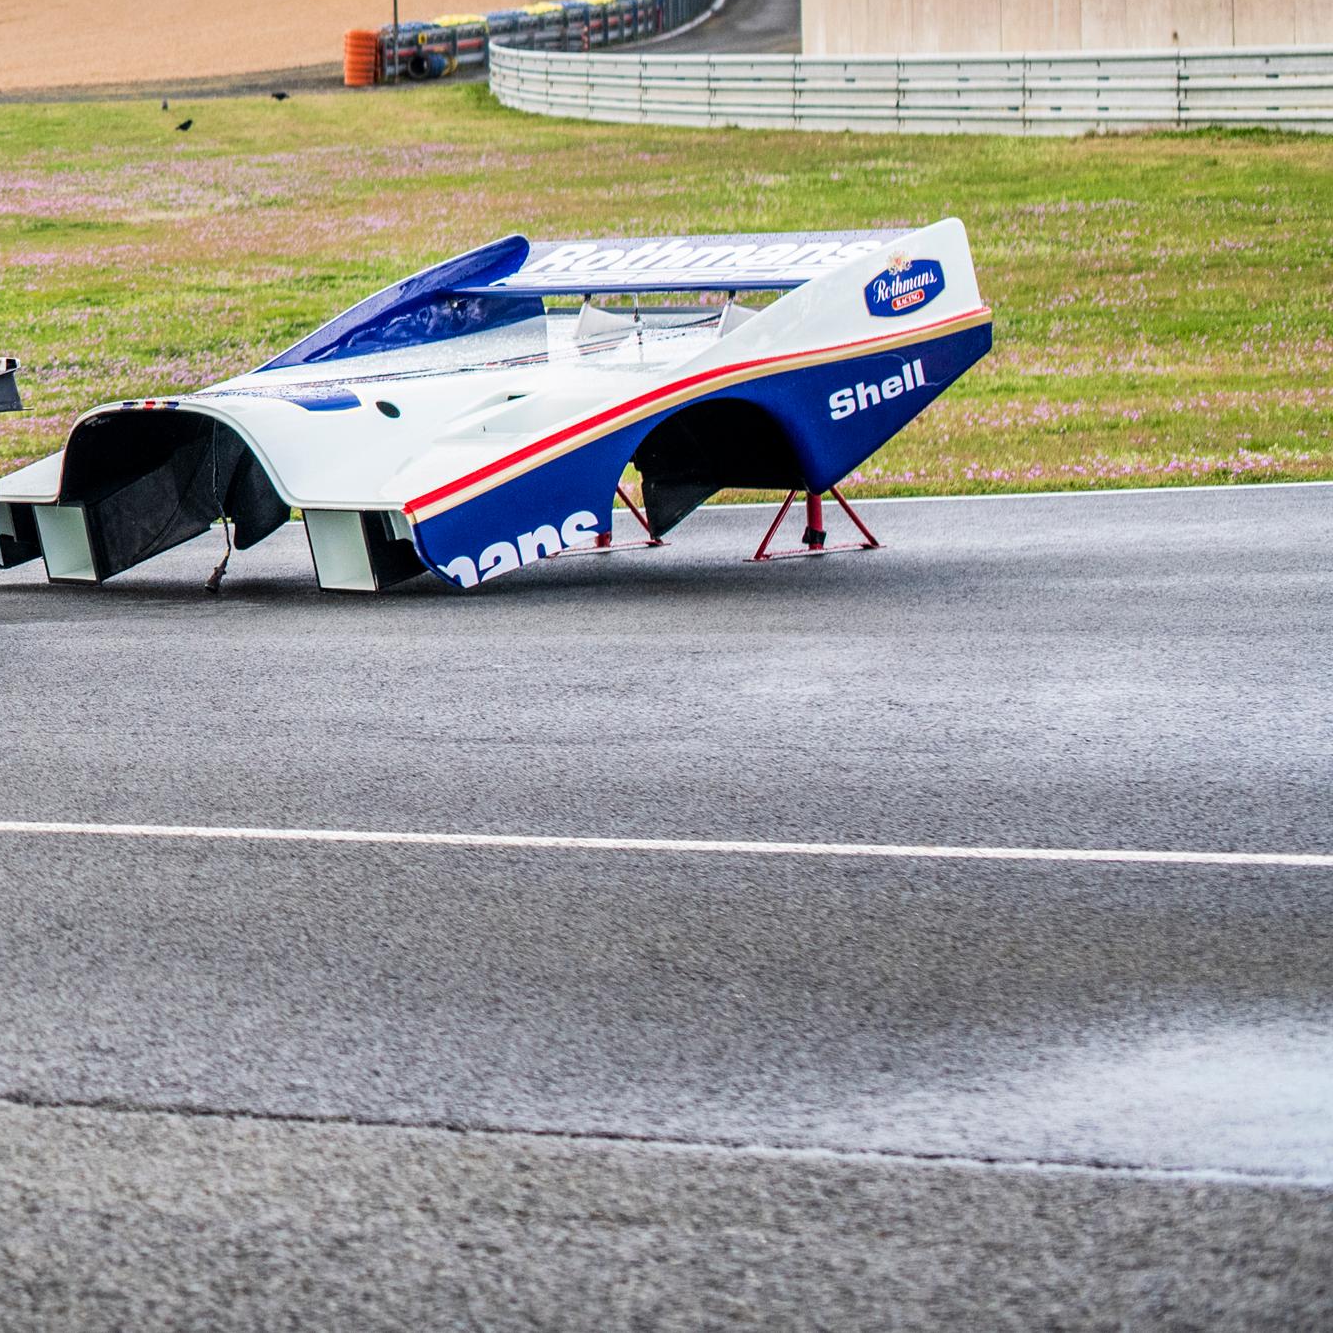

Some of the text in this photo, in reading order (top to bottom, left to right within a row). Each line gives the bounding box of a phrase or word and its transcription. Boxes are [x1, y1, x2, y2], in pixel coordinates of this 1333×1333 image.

[533, 240, 881, 272] Rothmans
[873, 268, 938, 304] Rothmans
[895, 292, 921, 308] RACING
[829, 359, 926, 421] Shell
